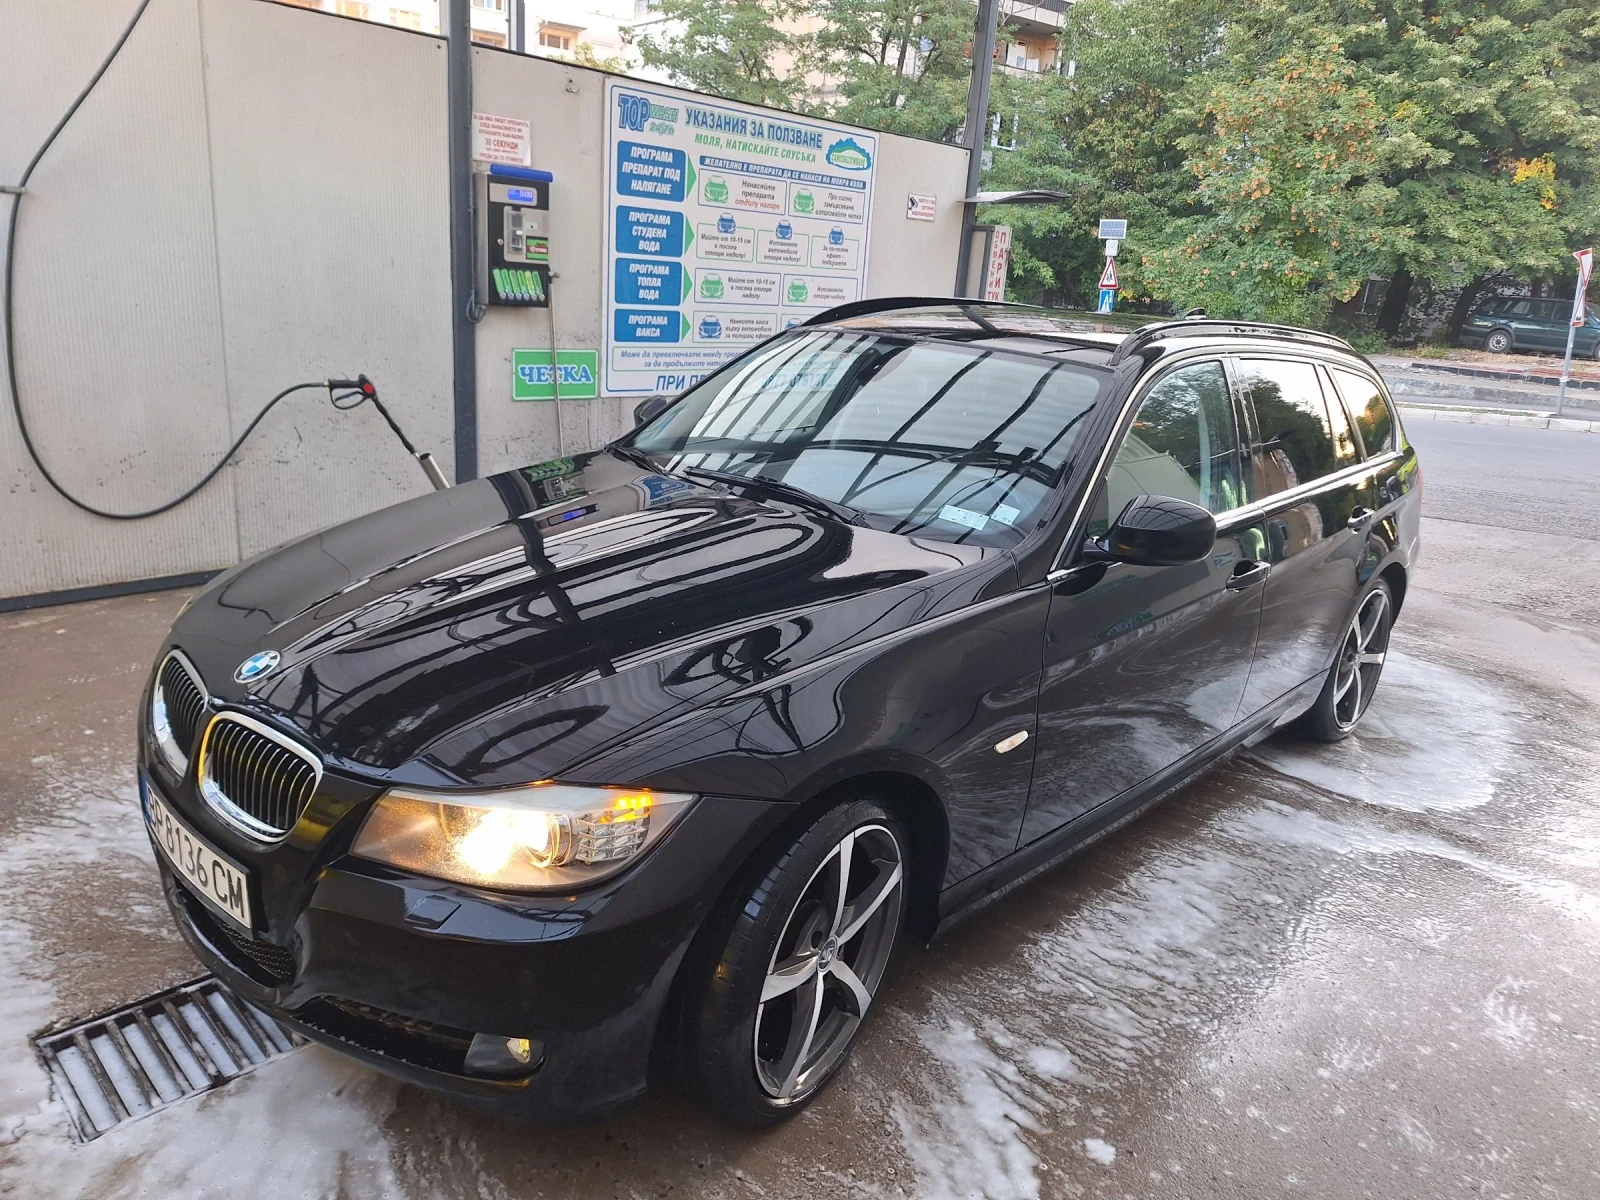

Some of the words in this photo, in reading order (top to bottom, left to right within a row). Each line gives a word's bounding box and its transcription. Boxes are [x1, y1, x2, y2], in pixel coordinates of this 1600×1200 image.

[618, 93, 650, 132] TOP
[650, 103, 679, 123] WASH
[685, 107, 747, 135] УКАЗАНИЯ
[750, 121, 764, 139] ЗА
[768, 124, 823, 148] ПОЛЗВАНЕ
[493, 139, 519, 150] СЕКУНДИ
[695, 133, 723, 149] МОЛЯ,
[726, 139, 779, 157] НАТИСКАЙТЕ
[781, 149, 816, 163] СПУСЪКА
[631, 146, 673, 163] ПРОГРАМА
[622, 161, 664, 177] ПРЕПАРАТ
[664, 168, 681, 182] ПОД
[704, 157, 742, 170] ЖЕЛАТЕЛНО
[748, 165, 782, 177] ПРЕПАРАТА
[782, 170, 791, 178] ДА
[792, 171, 799, 179] СЕ
[800, 173, 822, 181] НАНАСЯ
[831, 177, 849, 186] МОКРА
[631, 179, 672, 195] НАЛЯГАНЕ
[742, 180, 775, 191] Нанасяйте
[742, 190, 774, 200] препарата
[735, 198, 758, 208] отдолу
[760, 202, 780, 210] нагоре
[629, 211, 671, 225] ПРОГРАМА
[632, 226, 667, 239] СТУДЕНА
[701, 233, 719, 243] Мийте
[730, 236, 744, 244] 10-15
[638, 240, 660, 253] ВОДА
[705, 250, 725, 258] отгоре
[988, 230, 1000, 288] ОБМЕНИ
[994, 231, 1007, 289] ПАРИ
[629, 263, 670, 275] ПРОГРАМА
[637, 276, 661, 287] ТОПЛА
[728, 277, 746, 285] Мийте
[756, 278, 768, 286] 10-15
[638, 289, 659, 301] ВОДА
[742, 292, 760, 300] надолу
[987, 291, 1000, 301] ТУК
[628, 315, 668, 325] ПРОГРАМА
[635, 327, 660, 337] ВАКСА
[620, 350, 640, 358] Може
[642, 350, 651, 358] да
[652, 351, 701, 359] превключвате
[702, 350, 723, 359] между
[653, 360, 661, 368] да
[662, 360, 705, 369] продължите
[518, 365, 593, 384] ЧЕТКА
[655, 375, 686, 391] ПРИ
[165, 814, 208, 888] 8136
[212, 859, 245, 919] CM
